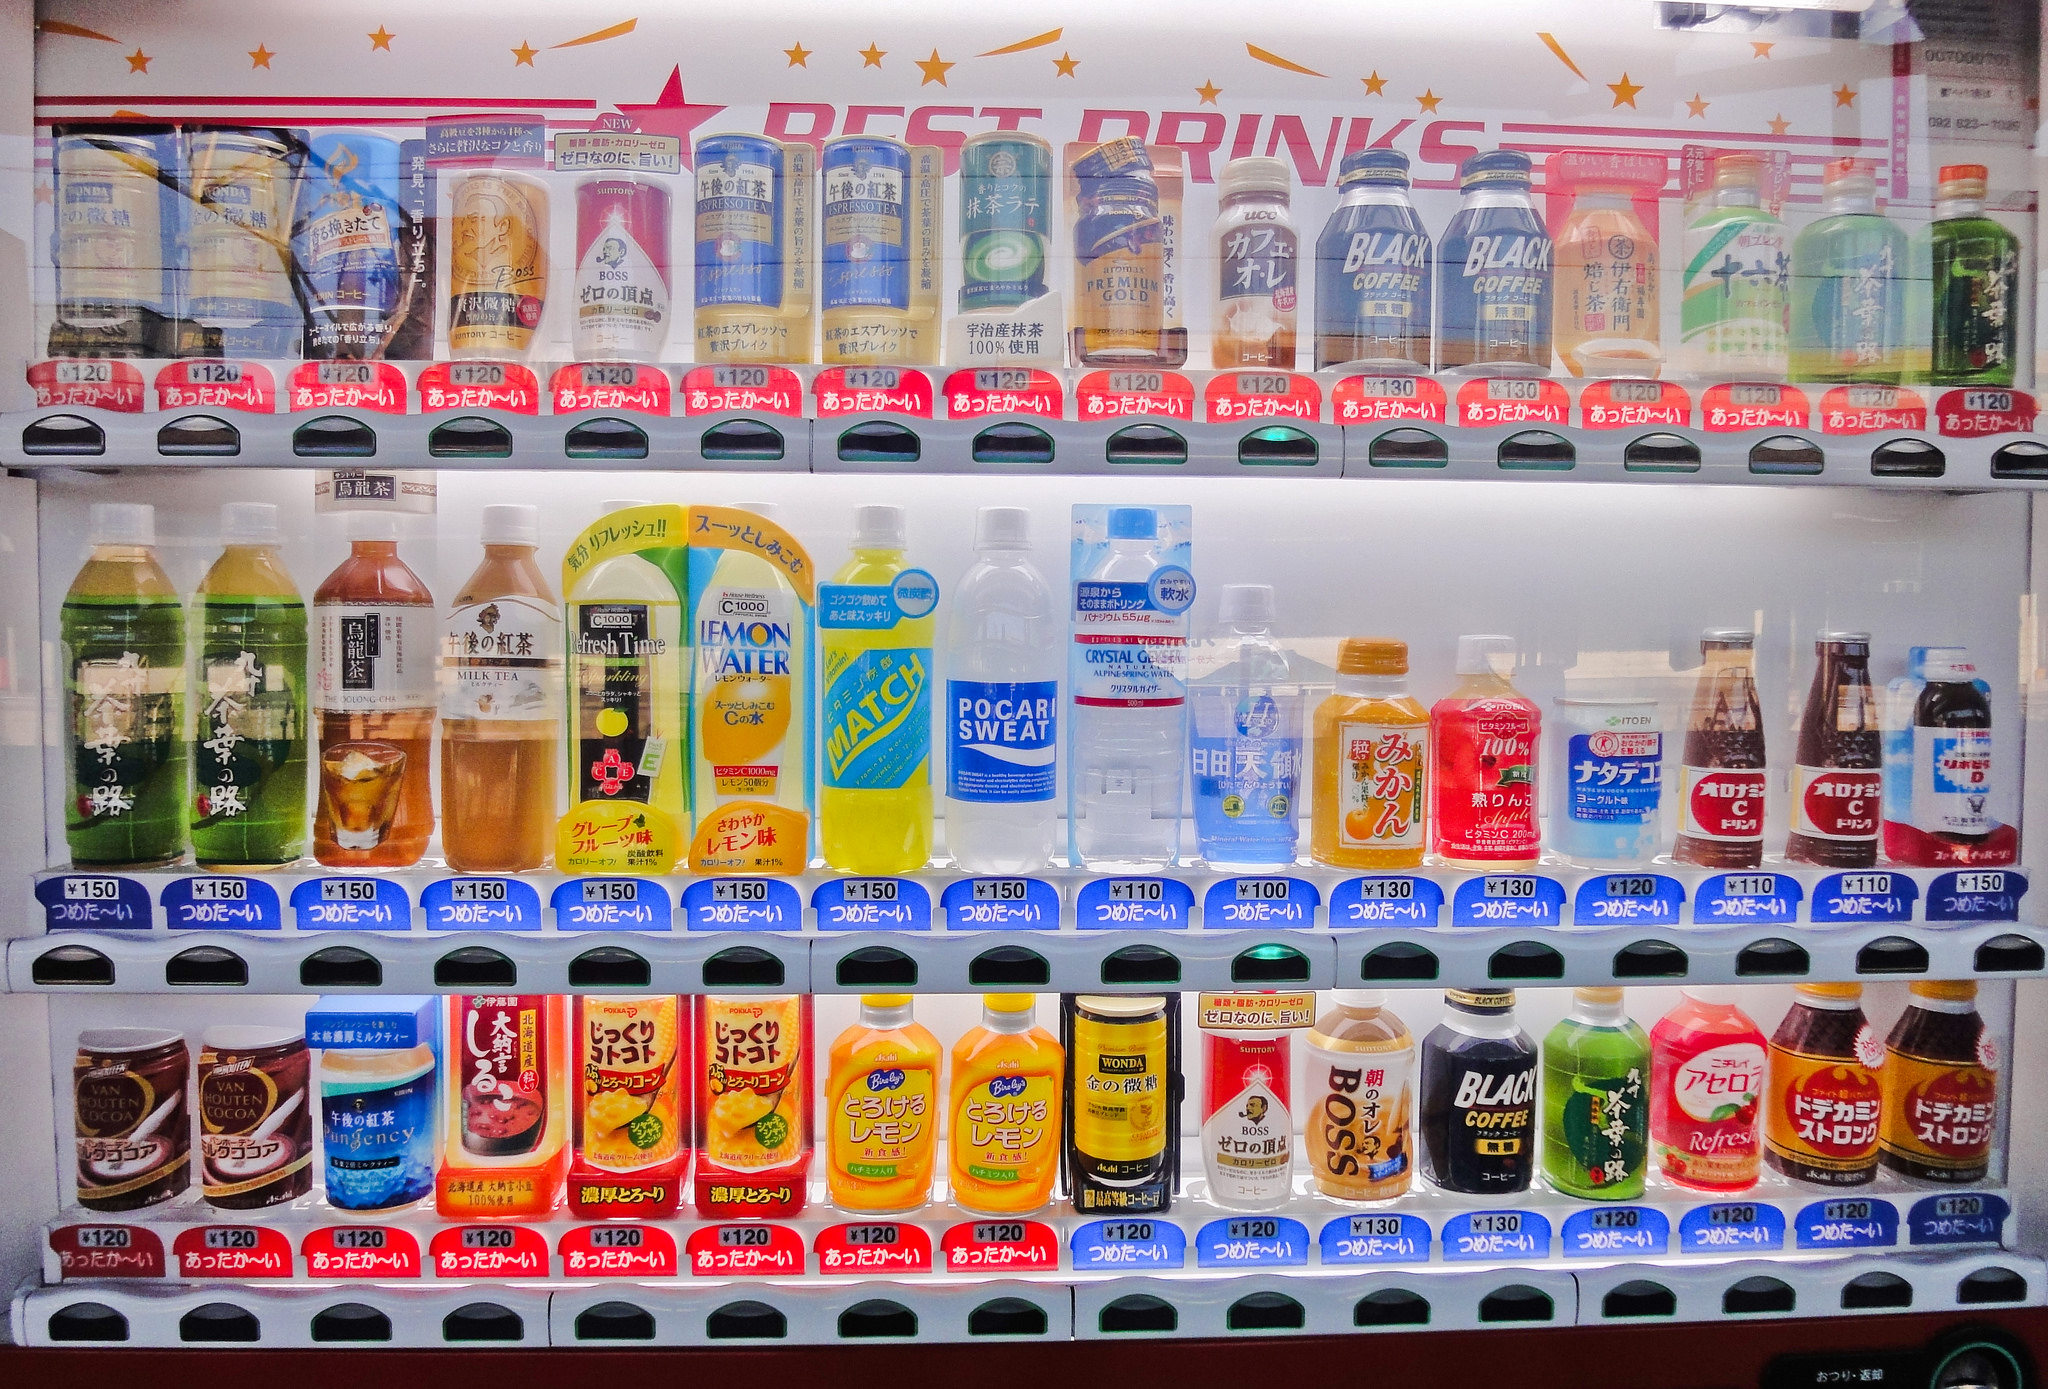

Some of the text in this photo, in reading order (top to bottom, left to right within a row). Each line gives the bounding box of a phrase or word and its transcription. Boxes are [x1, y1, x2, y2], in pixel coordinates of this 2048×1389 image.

[602, 119, 632, 129] NEW
[830, 181, 896, 202] 午後の紅茶
[966, 196, 1040, 219] 抹茶ラテ
[1343, 233, 1426, 273] BLACK
[1462, 236, 1551, 277] BLACK
[599, 271, 628, 281] BOSS
[1087, 275, 1159, 293] PREMIUM
[1353, 273, 1419, 291] COFFEE
[1474, 276, 1542, 294] COFFEE
[1584, 263, 1605, 312] 焙じ茶
[580, 286, 654, 306] ゼロの頂点
[1103, 288, 1149, 301] GOLD
[1612, 263, 1631, 331] 伊右衛門
[698, 324, 787, 339] 紅茶のエスプレッソで
[826, 324, 918, 340] 紅茶のエスプレッソで
[966, 323, 1044, 338] 宇治産抹茶
[839, 341, 897, 354] 贅沢ブレイク
[969, 340, 1040, 355] 100% 使用
[1243, 353, 1273, 362] コーヒー
[62, 365, 108, 381] ¥120
[194, 365, 239, 382] ¥120
[323, 365, 370, 382] ¥120
[455, 367, 501, 383] ¥120
[587, 368, 633, 384] ¥120
[719, 369, 765, 386] ¥120
[850, 371, 896, 388] ¥120
[980, 371, 1026, 388] ¥120
[1115, 375, 1159, 391] ¥120
[1242, 377, 1286, 392] ¥120
[1367, 379, 1414, 396] ¥130
[1490, 381, 1537, 398] ¥130
[1970, 394, 2009, 410] ¥120
[338, 481, 391, 497] 烏龍茶
[696, 515, 803, 574] スーッとしみこむ
[830, 595, 887, 606] ゴクゴク飲めて
[1080, 587, 1122, 598] 源泉から
[1160, 587, 1189, 601] 軟水
[722, 601, 765, 613] C1000
[1080, 599, 1146, 610] そのままボトリング
[829, 610, 890, 622] あと味スッキリ
[1084, 613, 1120, 622] バナジウム
[701, 620, 791, 648] LEMON
[347, 622, 364, 678] 烏龍茶
[449, 631, 534, 655] 午後の紅茶
[619, 632, 665, 655] Time
[702, 649, 790, 674] WATER
[1086, 649, 1133, 663] CRYSTAL
[458, 672, 519, 681] MILK TEA
[1110, 685, 1162, 693] クリスタルガイザー
[826, 653, 925, 760] MATCH
[959, 698, 1055, 720] POCARI
[724, 711, 764, 725] Cの水
[959, 720, 1049, 741] SWEAT
[1481, 738, 1529, 756] 100%
[722, 778, 768, 787] レモン50個分
[1373, 732, 1412, 838] みかん
[1577, 794, 1628, 805] ヨーグルト味
[1732, 801, 1747, 815] C
[1848, 801, 1863, 815] C
[572, 815, 634, 839] グレープ
[717, 813, 765, 833] さわやか
[1721, 819, 1756, 830] ドリンク
[1837, 819, 1871, 830] ドリンク
[572, 829, 653, 855] フルーツ味
[707, 827, 777, 855] レモン味
[1465, 830, 1509, 839] ビタミンC
[627, 858, 657, 866] 果汁1%
[755, 859, 783, 867] 果汁1%
[67, 882, 116, 898] ¥150
[195, 882, 243, 898] ¥150
[846, 882, 897, 899] ¥150
[976, 882, 1025, 899] ¥150
[1239, 882, 1287, 899] ¥100
[1364, 881, 1411, 898] ¥130
[1487, 880, 1533, 896] ¥130
[1610, 879, 1652, 895] ¥120
[1728, 878, 1771, 893] ¥110
[1845, 877, 1888, 892] ¥110
[1960, 875, 2001, 890] ¥150
[325, 883, 374, 899] ¥150
[455, 883, 504, 899] ¥150
[586, 884, 635, 900] ¥150
[716, 884, 765, 899] ¥150
[1112, 883, 1161, 900] ¥110
[311, 1031, 409, 1042] 本格濃厚ミルクティー
[522, 1014, 533, 1067] 北海道産
[590, 1021, 655, 1044] じっくり
[715, 1021, 780, 1044] じっくり
[492, 1011, 517, 1074] 大納言
[466, 1009, 513, 1111] しるこ
[591, 1045, 656, 1065] コトコト
[716, 1045, 781, 1065] コトコト
[1102, 1057, 1143, 1069] WONDA
[216, 1082, 245, 1092] VAN
[1086, 1075, 1158, 1094] 金の微糖
[1454, 1065, 1537, 1109] BLACK
[844, 1094, 926, 1117] とろける
[1362, 1069, 1384, 1135] 朝のオレ
[1795, 1095, 1880, 1123] ドデカミン
[207, 1107, 257, 1119] COCOA
[331, 1111, 395, 1127] 午後の紅茶
[966, 1099, 1047, 1125] とろける
[1465, 1110, 1529, 1128] COFFEE
[1325, 1065, 1362, 1177] BOSS
[849, 1122, 922, 1143] レモン
[971, 1127, 1043, 1149] レモン
[1242, 1126, 1269, 1135] BOSS
[1798, 1119, 1878, 1145] ストロング
[1218, 1136, 1286, 1155] ゼロの頂点
[1097, 1164, 1149, 1173] Asahi コーヒー
[1233, 1158, 1277, 1166] カロリーゼロ
[1595, 1211, 1637, 1226] ¥120
[1712, 1206, 1754, 1223] ¥120
[1828, 1203, 1868, 1219] ¥120
[1107, 1223, 1151, 1240] ¥120
[1231, 1221, 1276, 1237] ¥120
[1353, 1219, 1399, 1235] ¥130
[1473, 1216, 1519, 1232] ¥130
[83, 1230, 128, 1246] ¥120
[209, 1231, 255, 1246] ¥120
[338, 1231, 383, 1246] ¥120
[466, 1231, 512, 1246] ¥120
[595, 1229, 640, 1246] ¥120
[723, 1229, 768, 1245] ¥120
[850, 1227, 896, 1243] ¥120
[977, 1225, 1023, 1242] ¥120
[1816, 1369, 1883, 1383] おつり・返却
